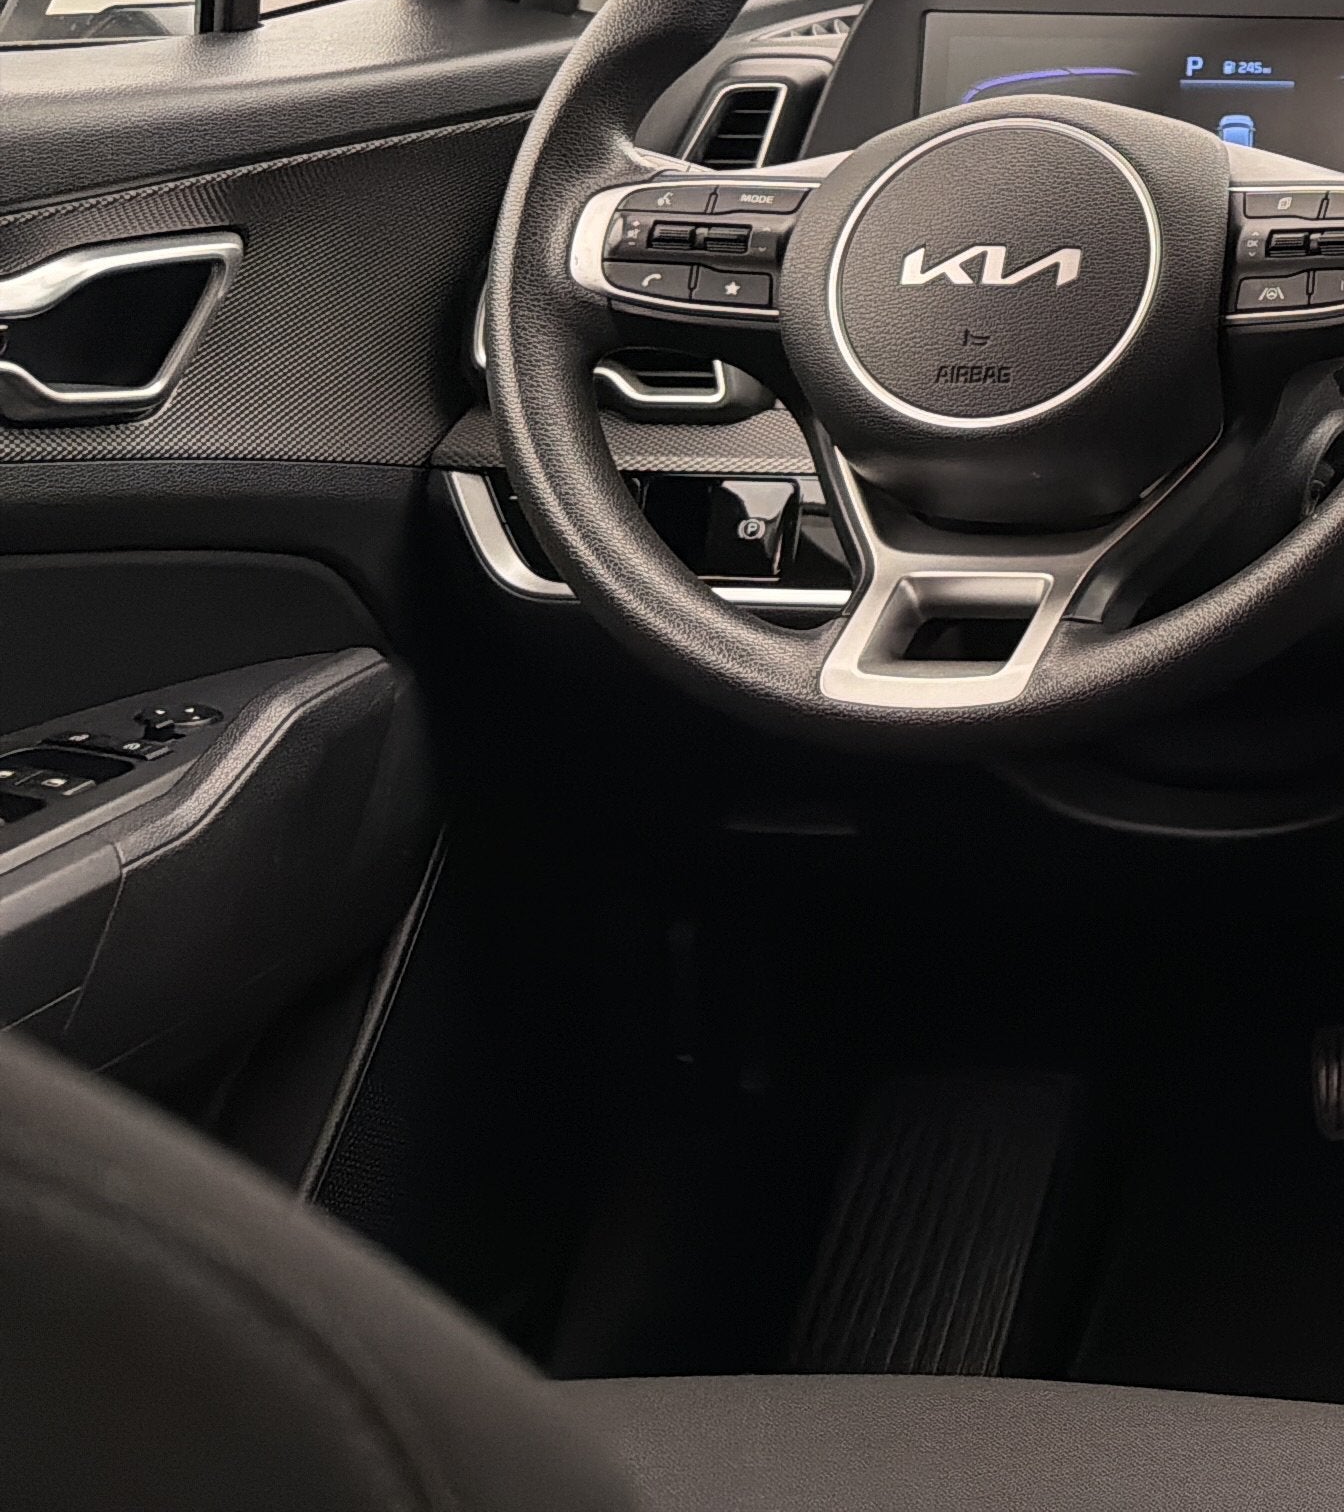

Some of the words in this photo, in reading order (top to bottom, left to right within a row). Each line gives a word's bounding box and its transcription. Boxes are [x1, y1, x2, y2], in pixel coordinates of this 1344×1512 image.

[1185, 55, 1204, 77] P
[1238, 61, 1262, 74] 245
[740, 193, 775, 204] MODE
[901, 245, 1082, 287] KIA
[934, 364, 1014, 384] AIRBAG
